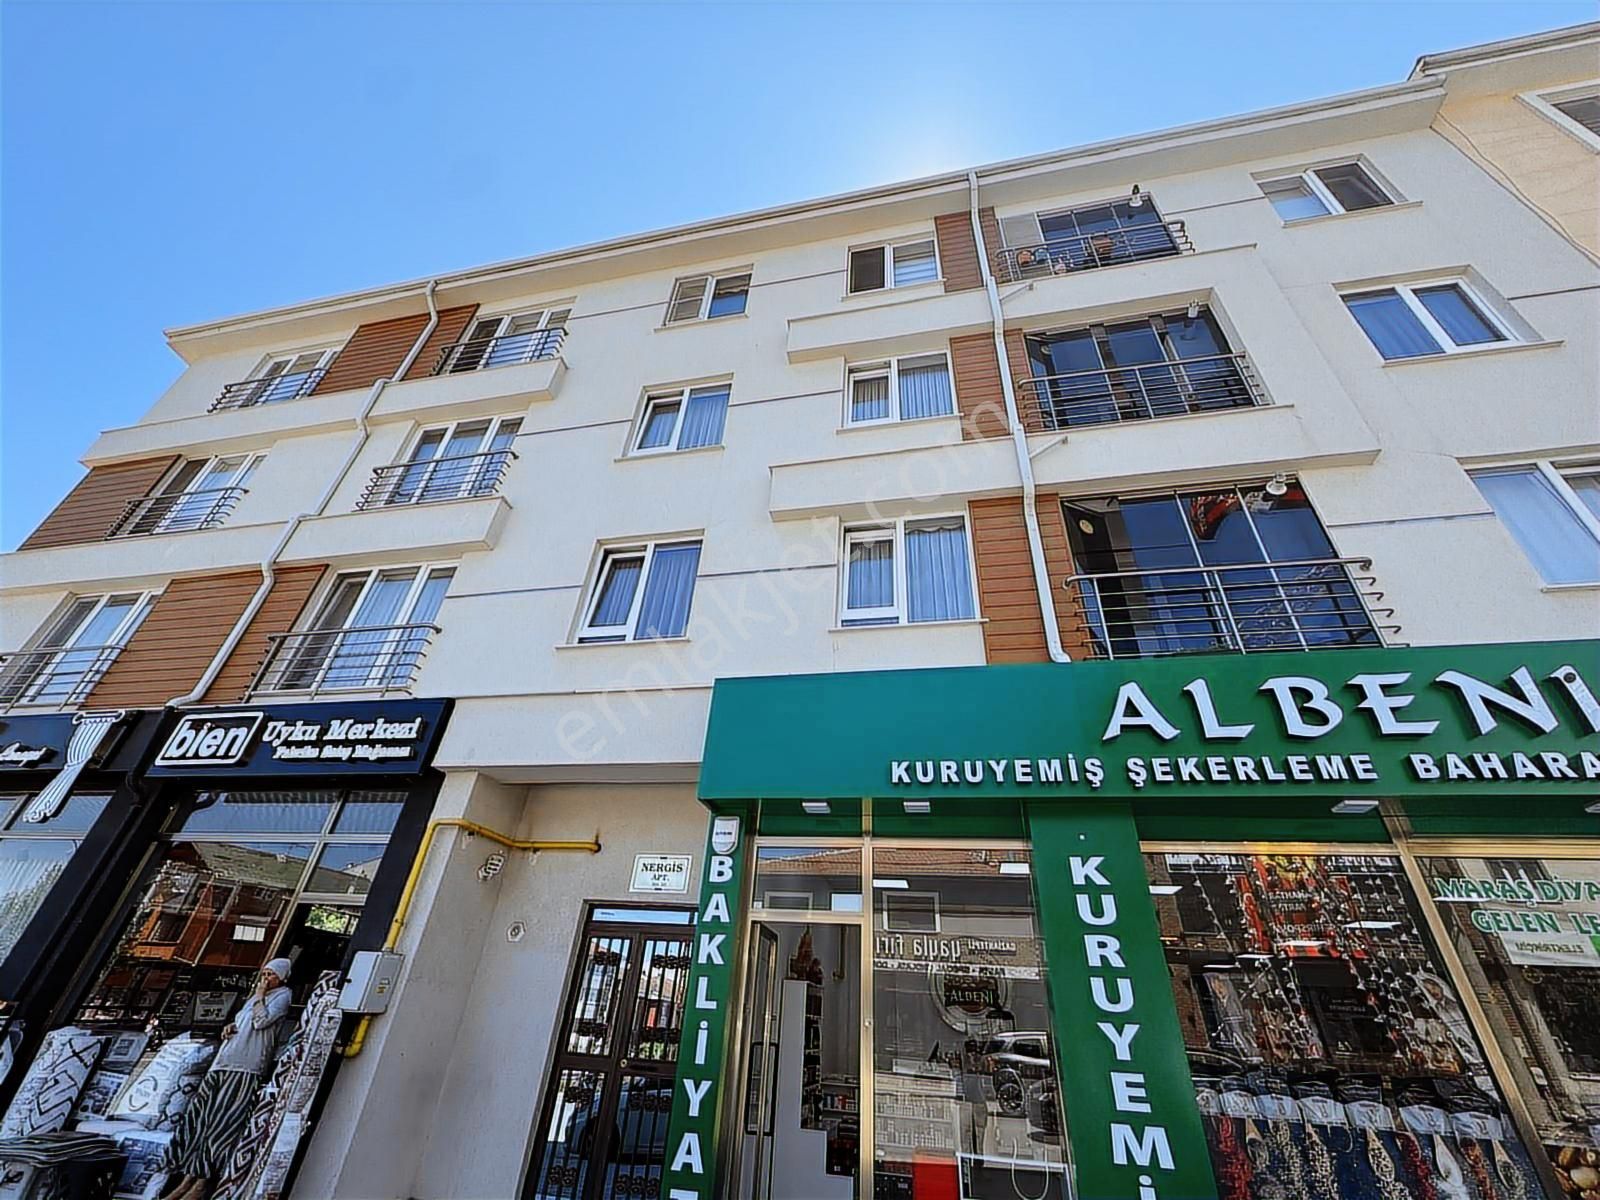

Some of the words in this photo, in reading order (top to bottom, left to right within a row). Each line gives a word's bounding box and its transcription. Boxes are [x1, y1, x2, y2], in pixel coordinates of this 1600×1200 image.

[164, 721, 249, 758] bien
[891, 752, 1105, 788] KURUYEMİŞ
[1126, 752, 1379, 788] ŞEKERLEME
[1408, 751, 1600, 780] BAHARA
[1435, 877, 1537, 907] MARAŞ
[1471, 909, 1561, 934] GELEN
[669, 855, 734, 1200] BAKLİYA
